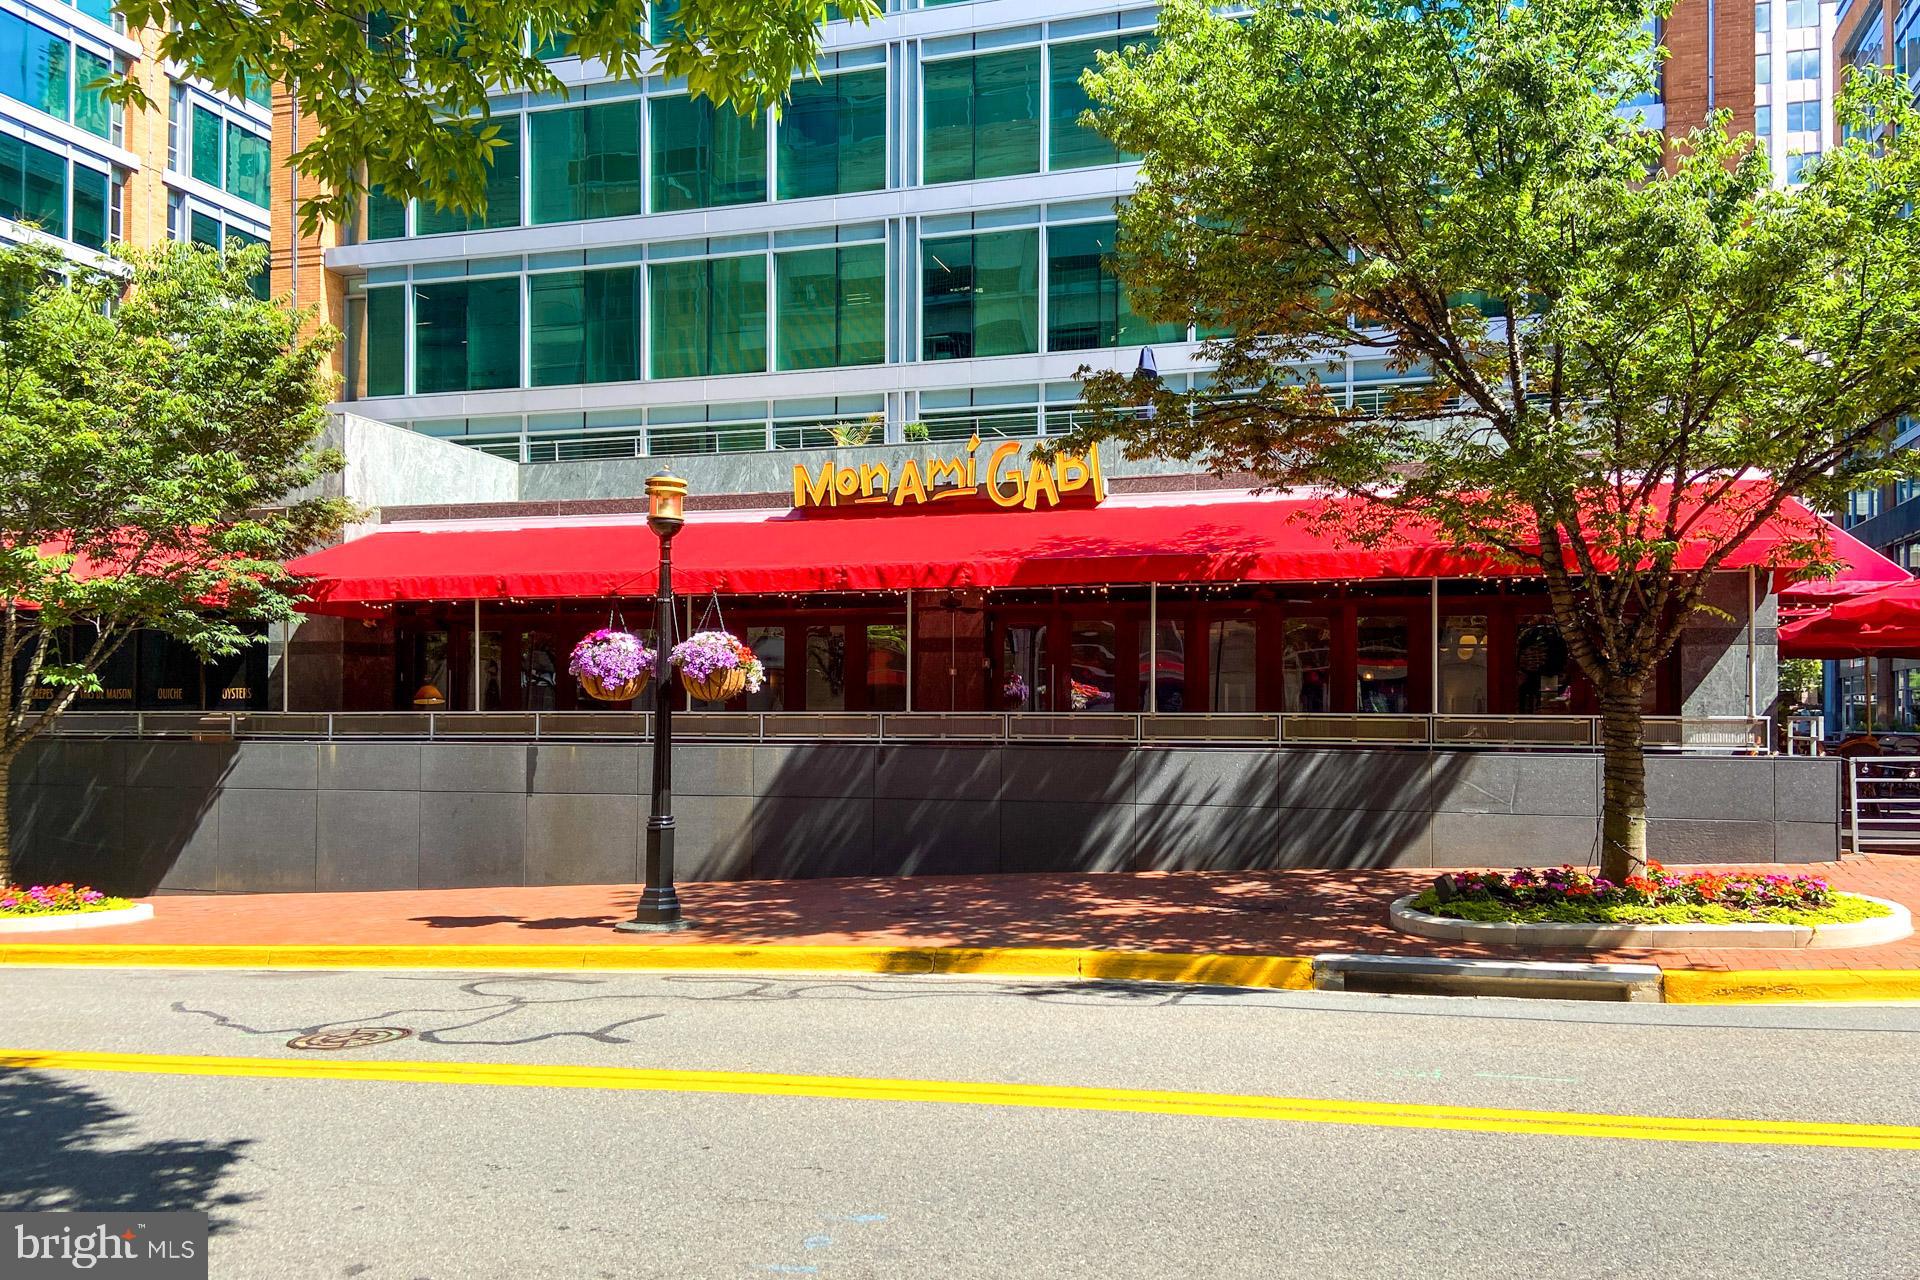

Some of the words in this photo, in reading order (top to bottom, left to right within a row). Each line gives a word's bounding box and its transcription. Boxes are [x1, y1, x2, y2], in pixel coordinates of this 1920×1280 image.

[106, 687, 133, 700] MAISON
[157, 687, 183, 700] QUICHE
[222, 687, 252, 700] OYSTERS
